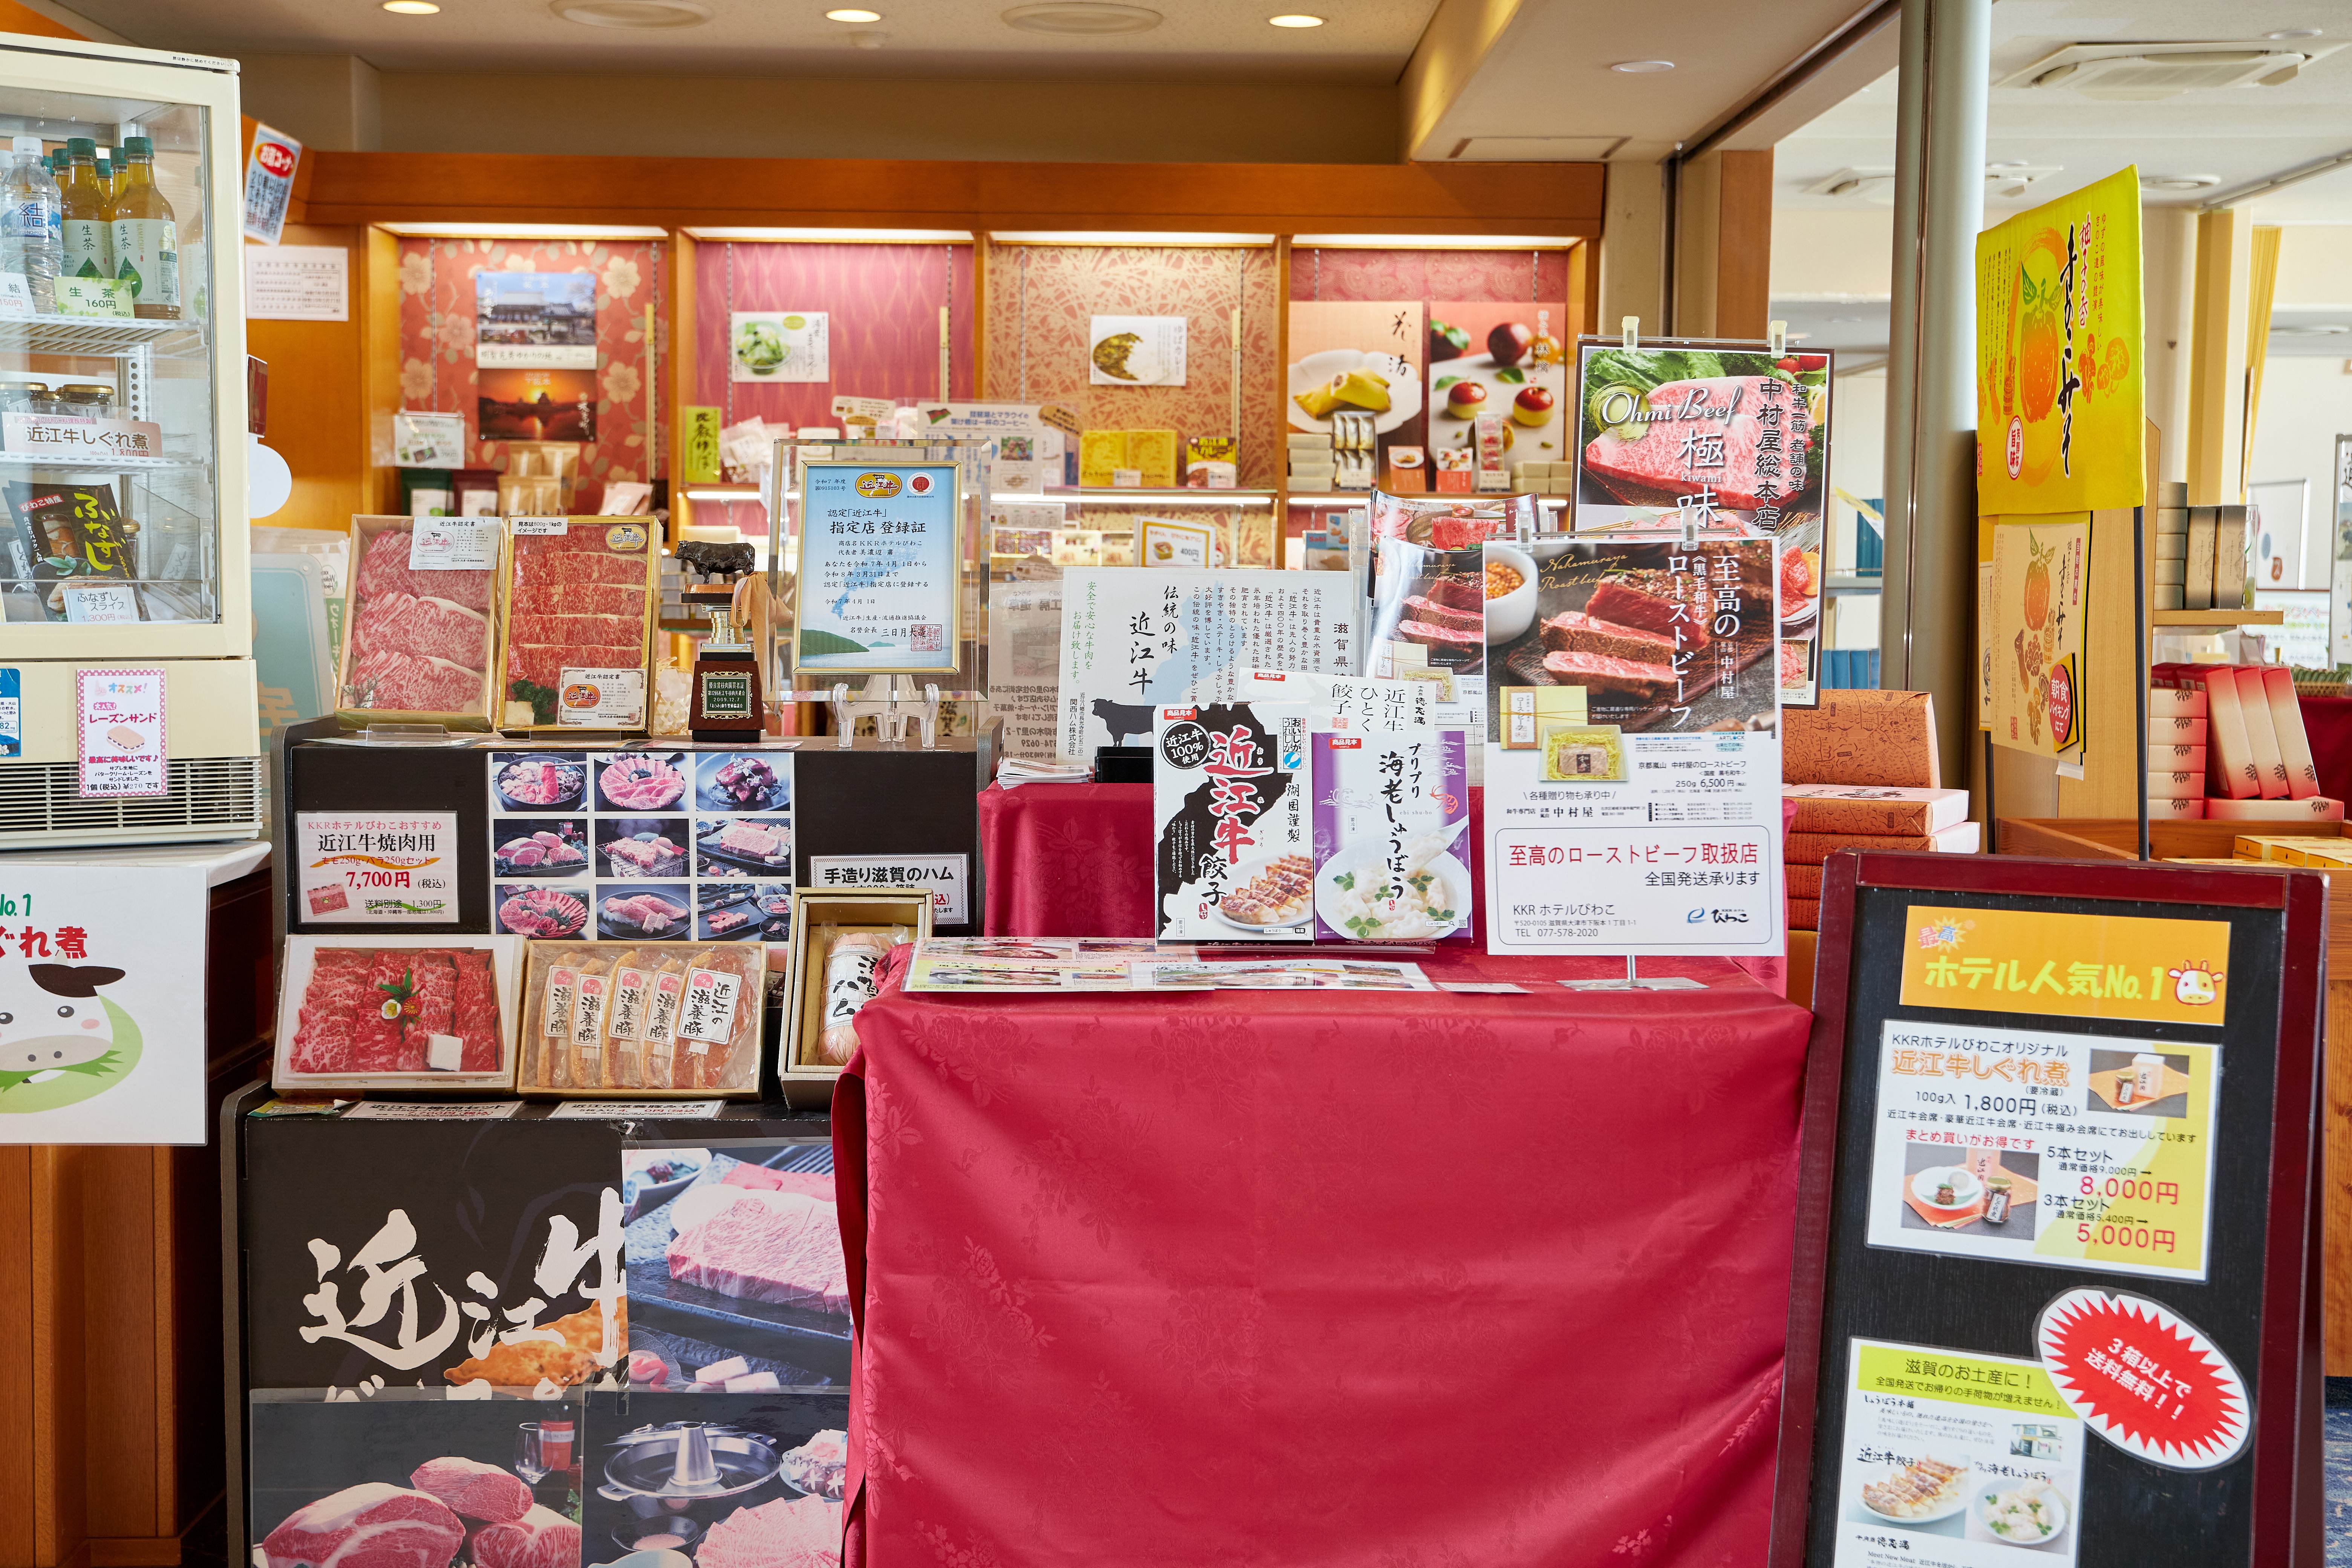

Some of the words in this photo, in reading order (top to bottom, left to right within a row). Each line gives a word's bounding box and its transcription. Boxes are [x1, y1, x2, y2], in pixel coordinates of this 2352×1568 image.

[81, 225, 95, 250] 生茶
[119, 224, 131, 250] 生茶
[8, 283, 20, 293] 結
[2096, 214, 2107, 352] ゆずの風味が美味しい
[86, 300, 116, 309] 160円
[1602, 392, 1672, 424] Ohmi
[1677, 385, 1741, 426] Beef
[1790, 383, 1807, 432] 和牛一筋
[26, 426, 149, 450] 近江牛しぐれ煮
[1677, 428, 1724, 470] 極
[2010, 429, 2016, 468] 旨味
[1752, 378, 1783, 530] 中村屋総本店
[1788, 438, 1805, 492] 老舗の味
[859, 480, 899, 495] 近江牛
[1680, 472, 1722, 484] kiwami
[20, 495, 63, 512] びわこ特産
[827, 509, 887, 518] 認定「近江牛」
[1677, 484, 1723, 528] 味
[74, 488, 126, 571] ふなずし
[830, 522, 875, 534] 指定店
[880, 522, 926, 533] 登録証
[420, 538, 452, 550] 近江牛
[609, 534, 643, 547] 近江牛
[1539, 553, 1628, 573] Nakamuraya
[1538, 576, 1579, 593] Roast
[1713, 554, 1740, 637] 至高の
[78, 593, 119, 602] ふなずし
[91, 602, 124, 610] スライス
[82, 613, 115, 622] 1,300円
[1084, 581, 1097, 670] 安全で安心な牛肉を
[1161, 585, 1179, 654] 伝統の味
[1204, 586, 1213, 666] 大好評を博しています。
[1265, 591, 1273, 667] 「近江牛」は厳選された
[1312, 588, 1321, 672] 近江牛は貴重な水資源で
[1669, 555, 1692, 728] ローストビーフ
[1070, 611, 1081, 684] お届け致します。
[1129, 611, 1156, 695] 近江牛
[1227, 587, 1236, 701] その独特のとろけるような豊かな
[1720, 656, 1734, 699] 中村屋
[567, 692, 597, 704] 近江牛
[1330, 683, 1353, 714] 餃子
[2051, 677, 2069, 703] 朝食
[89, 714, 156, 723] レーズンサンド
[2049, 704, 2070, 721] バイキング
[1067, 698, 1078, 756] 関西ハム株式会社
[1165, 728, 1204, 748] 近江牛
[2055, 721, 2064, 733] にて
[1170, 740, 1204, 760] 100%
[1182, 753, 1199, 764] 使用
[1409, 743, 1422, 799] プリプリ
[1203, 724, 1274, 864] 近江牛
[1530, 791, 1610, 800] 各種贈り物も承り中
[1286, 783, 1300, 842] 湖国謹製
[1554, 807, 1593, 818] 中村屋
[308, 821, 441, 830] KKRホテルびわこおすすめ
[1378, 751, 1409, 900] 海老しゅうぼう
[318, 834, 435, 852] 近江牛焼肉用
[1509, 842, 1758, 867] 至高のローストビーフ取扱店
[346, 871, 410, 890] 7,700円
[418, 879, 446, 889] (税込)
[824, 867, 954, 884] 手造り滋賀のハム
[1200, 854, 1228, 905] 餃子
[1645, 871, 1760, 887] 全国発送承ります
[365, 899, 402, 908] 送料別途
[412, 900, 441, 908] 1,300円
[1513, 905, 1536, 916] KKR
[1539, 904, 1615, 916] ホテルびわこ
[1711, 909, 1749, 923] びわこ
[1516, 929, 1531, 937] TEL
[1537, 928, 1598, 937] 077-578-2020
[1917, 925, 1957, 949] 最高
[1925, 955, 2165, 1001] ホテル人気No.1
[683, 989, 710, 1036] 滋養豚
[712, 982, 733, 1024] 近江の
[1891, 1034, 2069, 1057] KKRホテルびわこオリジナル
[1891, 1048, 2070, 1087] 近江牛しぐれ煮
[2026, 1085, 2064, 1097] (要冷蔵)
[1915, 1091, 1956, 1105] 100g入
[1963, 1093, 2036, 1116] 1,800円
[2041, 1104, 2077, 1116] (税込)
[1906, 1129, 2035, 1150] まとめ買いがお得です
[2047, 1146, 2113, 1162] 5本セット
[2043, 1194, 2110, 1210] 3本セット
[2080, 1175, 2179, 1205] 8,000円
[2055, 1210, 2134, 1225] 通常価格5,400円
[2076, 1223, 2176, 1253] 5,000円
[1905, 1358, 2031, 1389] 滋賀のお土産に!
[2107, 1337, 2192, 1398] 3箱以上で
[1875, 1376, 2061, 1410] 全国発送でお帰りの手荷物が増えません!
[1857, 1447, 1916, 1468] 近江牛餃子
